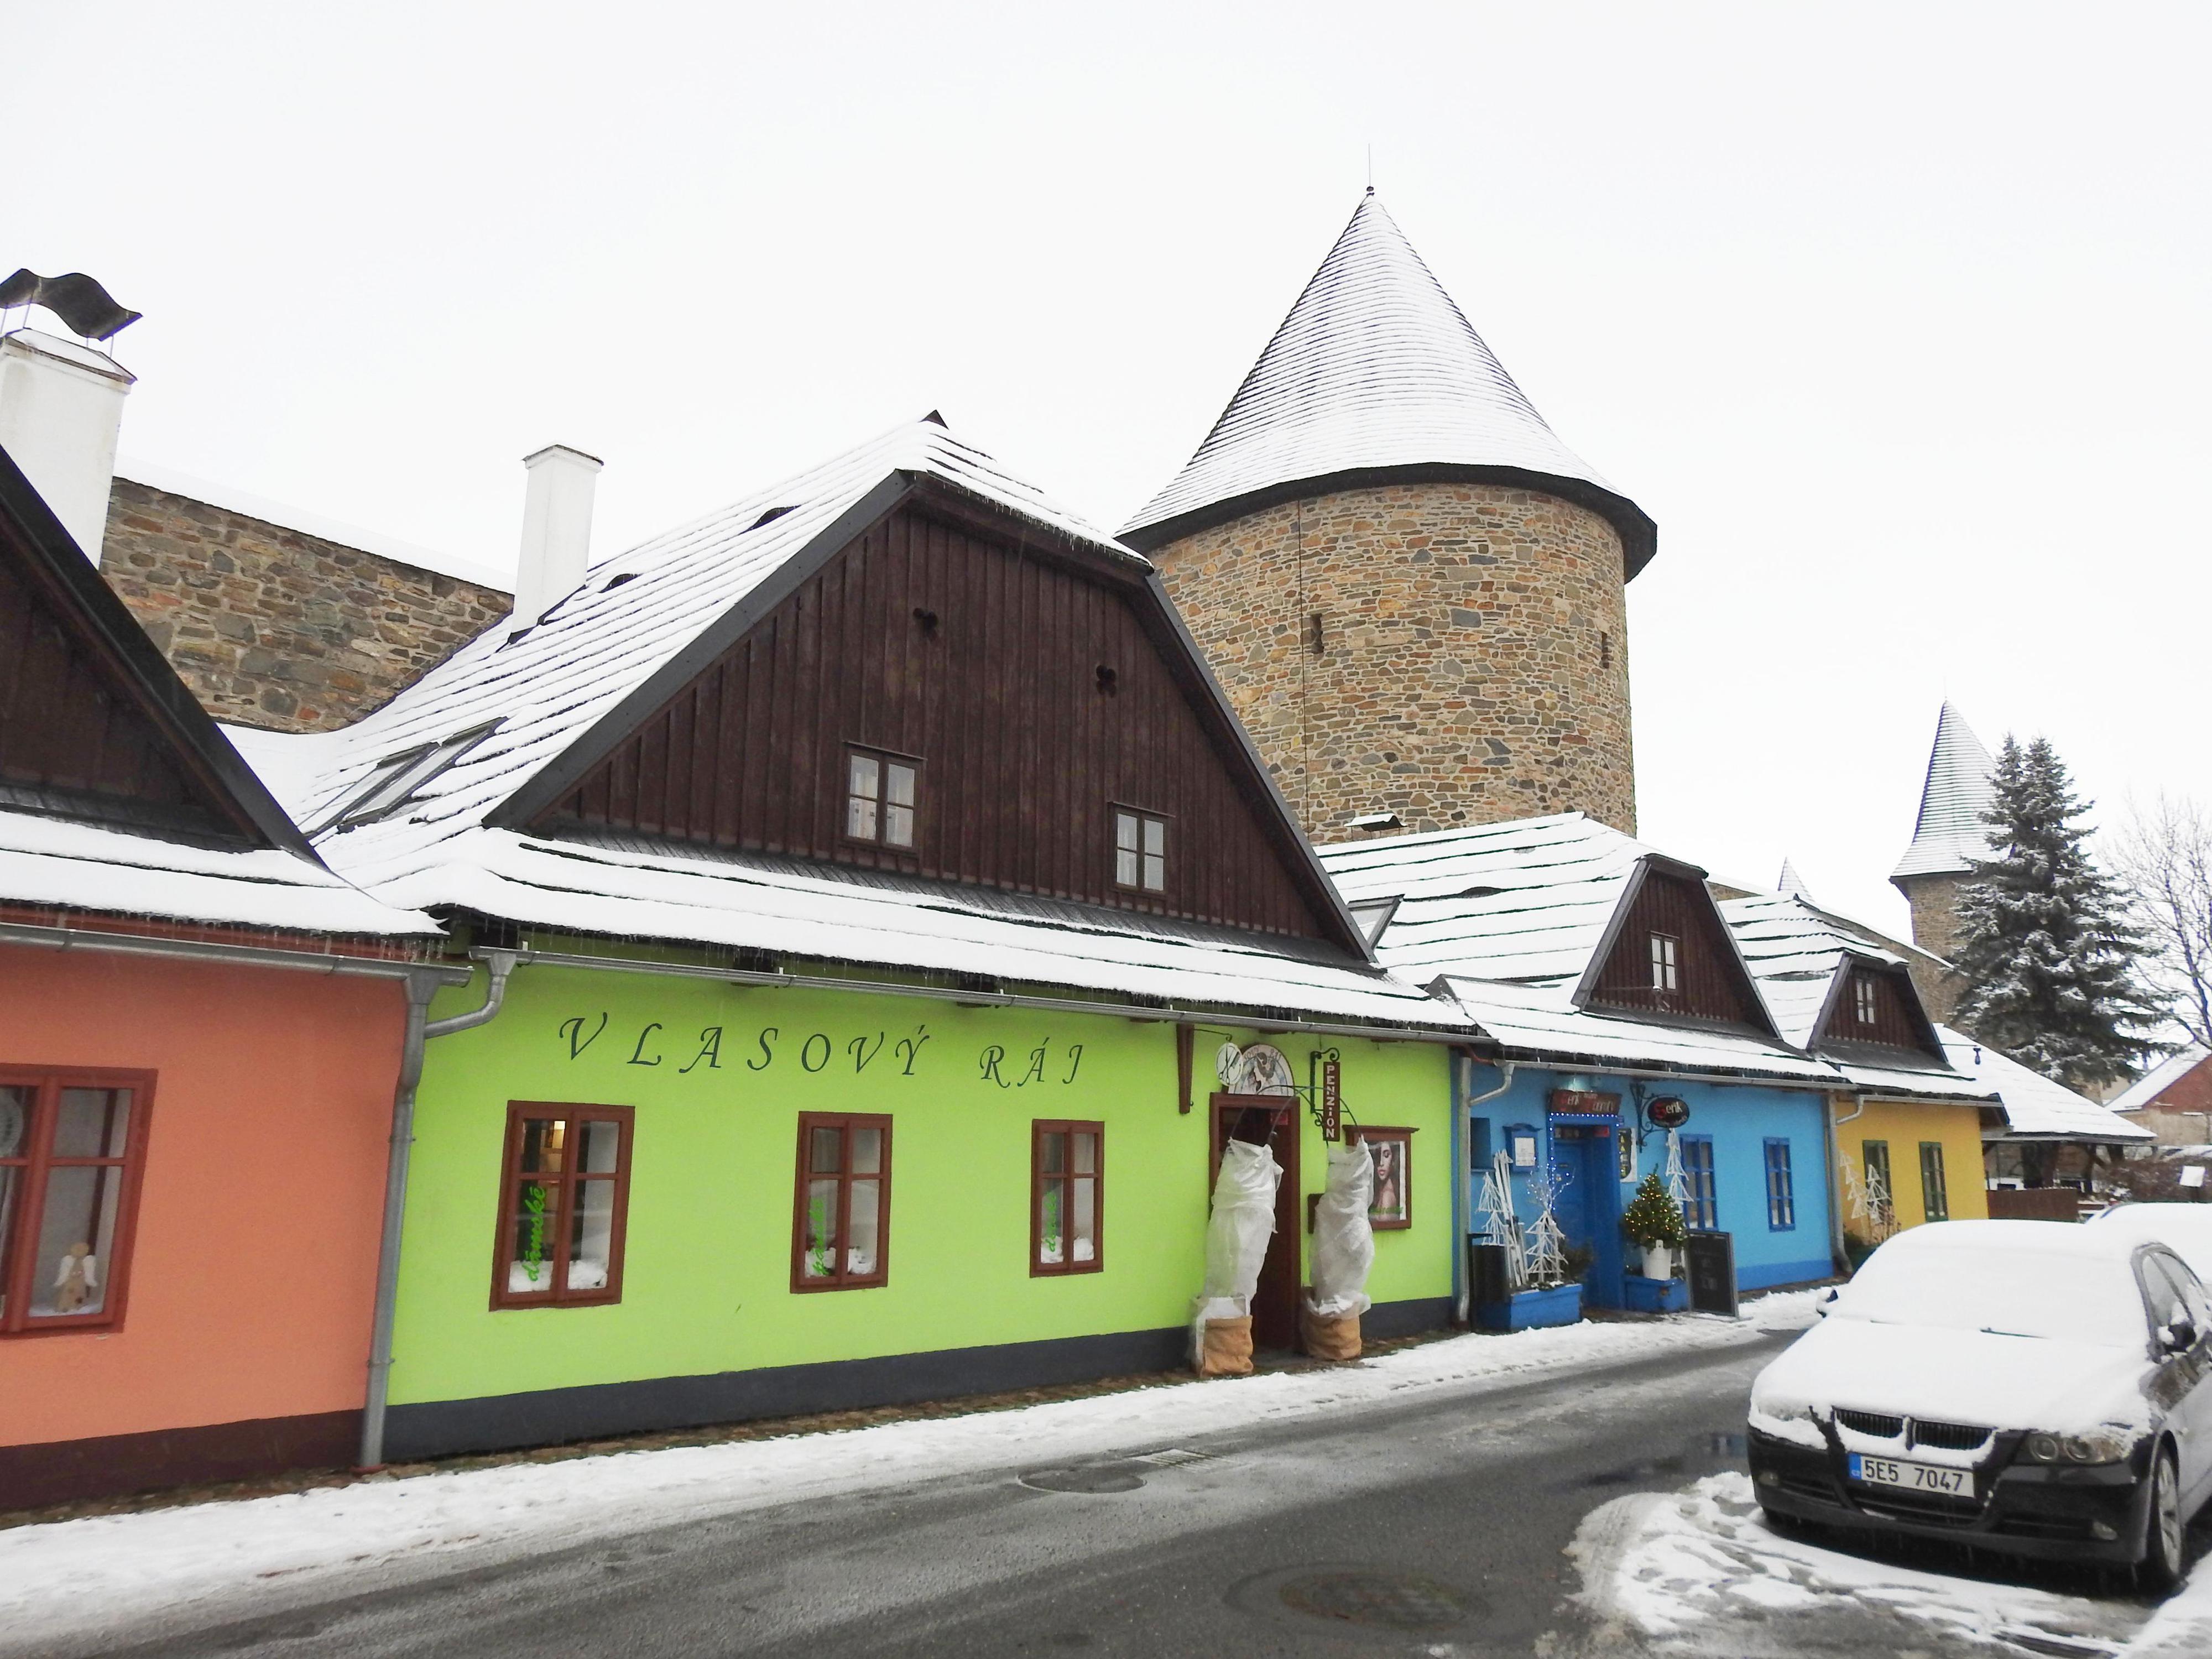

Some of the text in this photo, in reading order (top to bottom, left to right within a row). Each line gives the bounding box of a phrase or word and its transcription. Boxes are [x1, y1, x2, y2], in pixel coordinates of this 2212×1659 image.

[559, 1012, 1083, 1088] VLASOVÝ RÁJ
[1865, 1459, 1963, 1491] 5E5 7047
